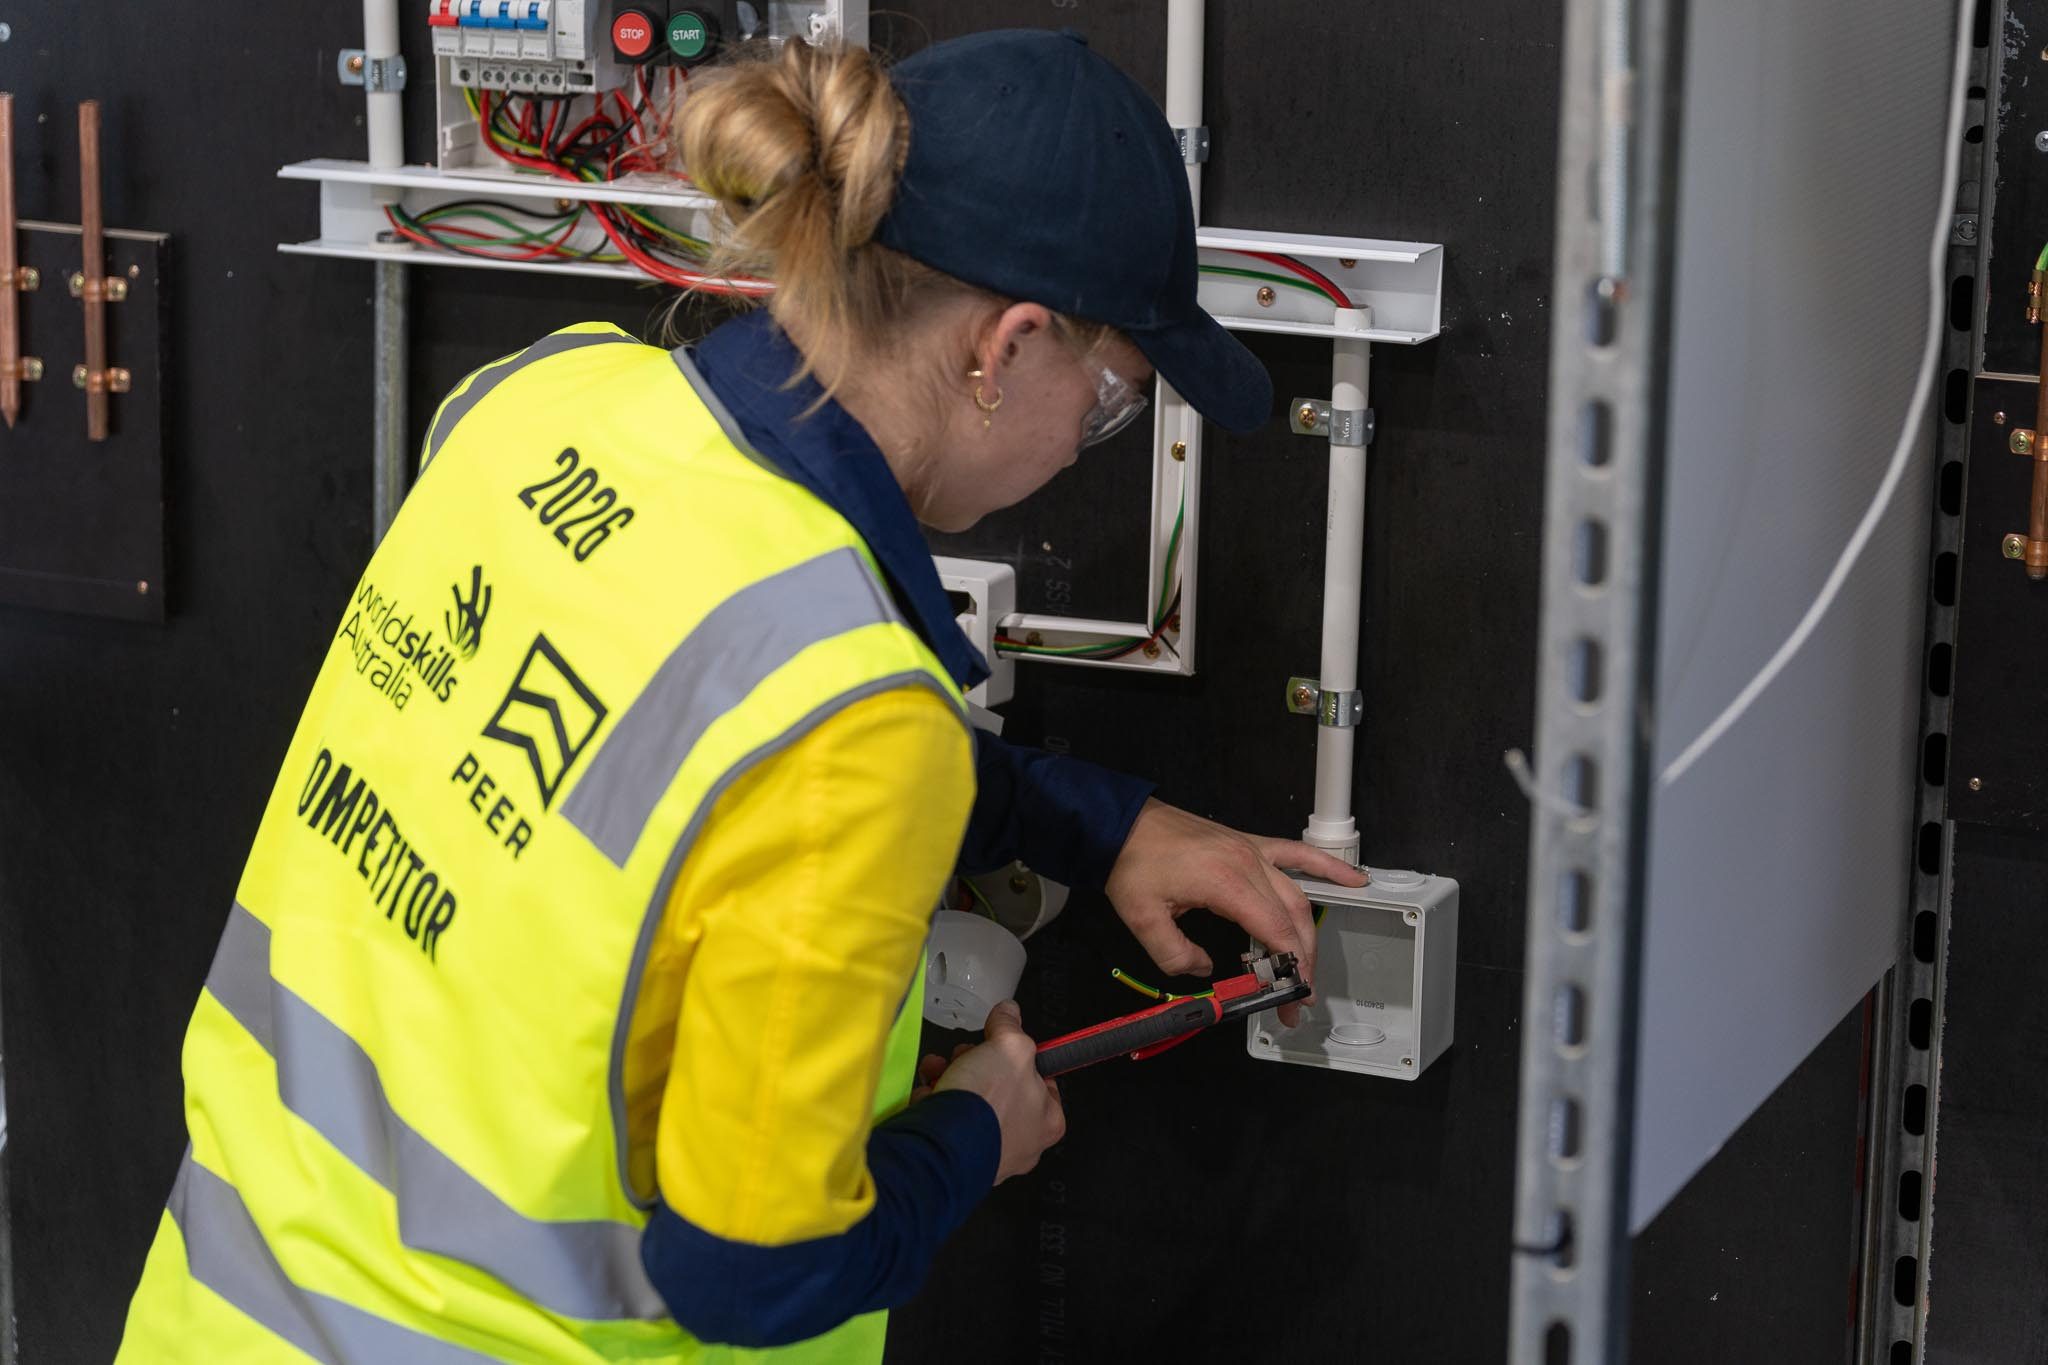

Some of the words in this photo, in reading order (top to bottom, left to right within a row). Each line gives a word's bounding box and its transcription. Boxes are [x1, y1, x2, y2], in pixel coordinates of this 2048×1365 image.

[620, 28, 645, 40] STOP
[672, 29, 700, 41] START
[518, 446, 634, 562] 2026
[451, 752, 533, 860] PEER
[297, 746, 457, 965] OMPETITOR
[1040, 1219, 1066, 1256] 333
[1039, 1263, 1065, 1288] NO
